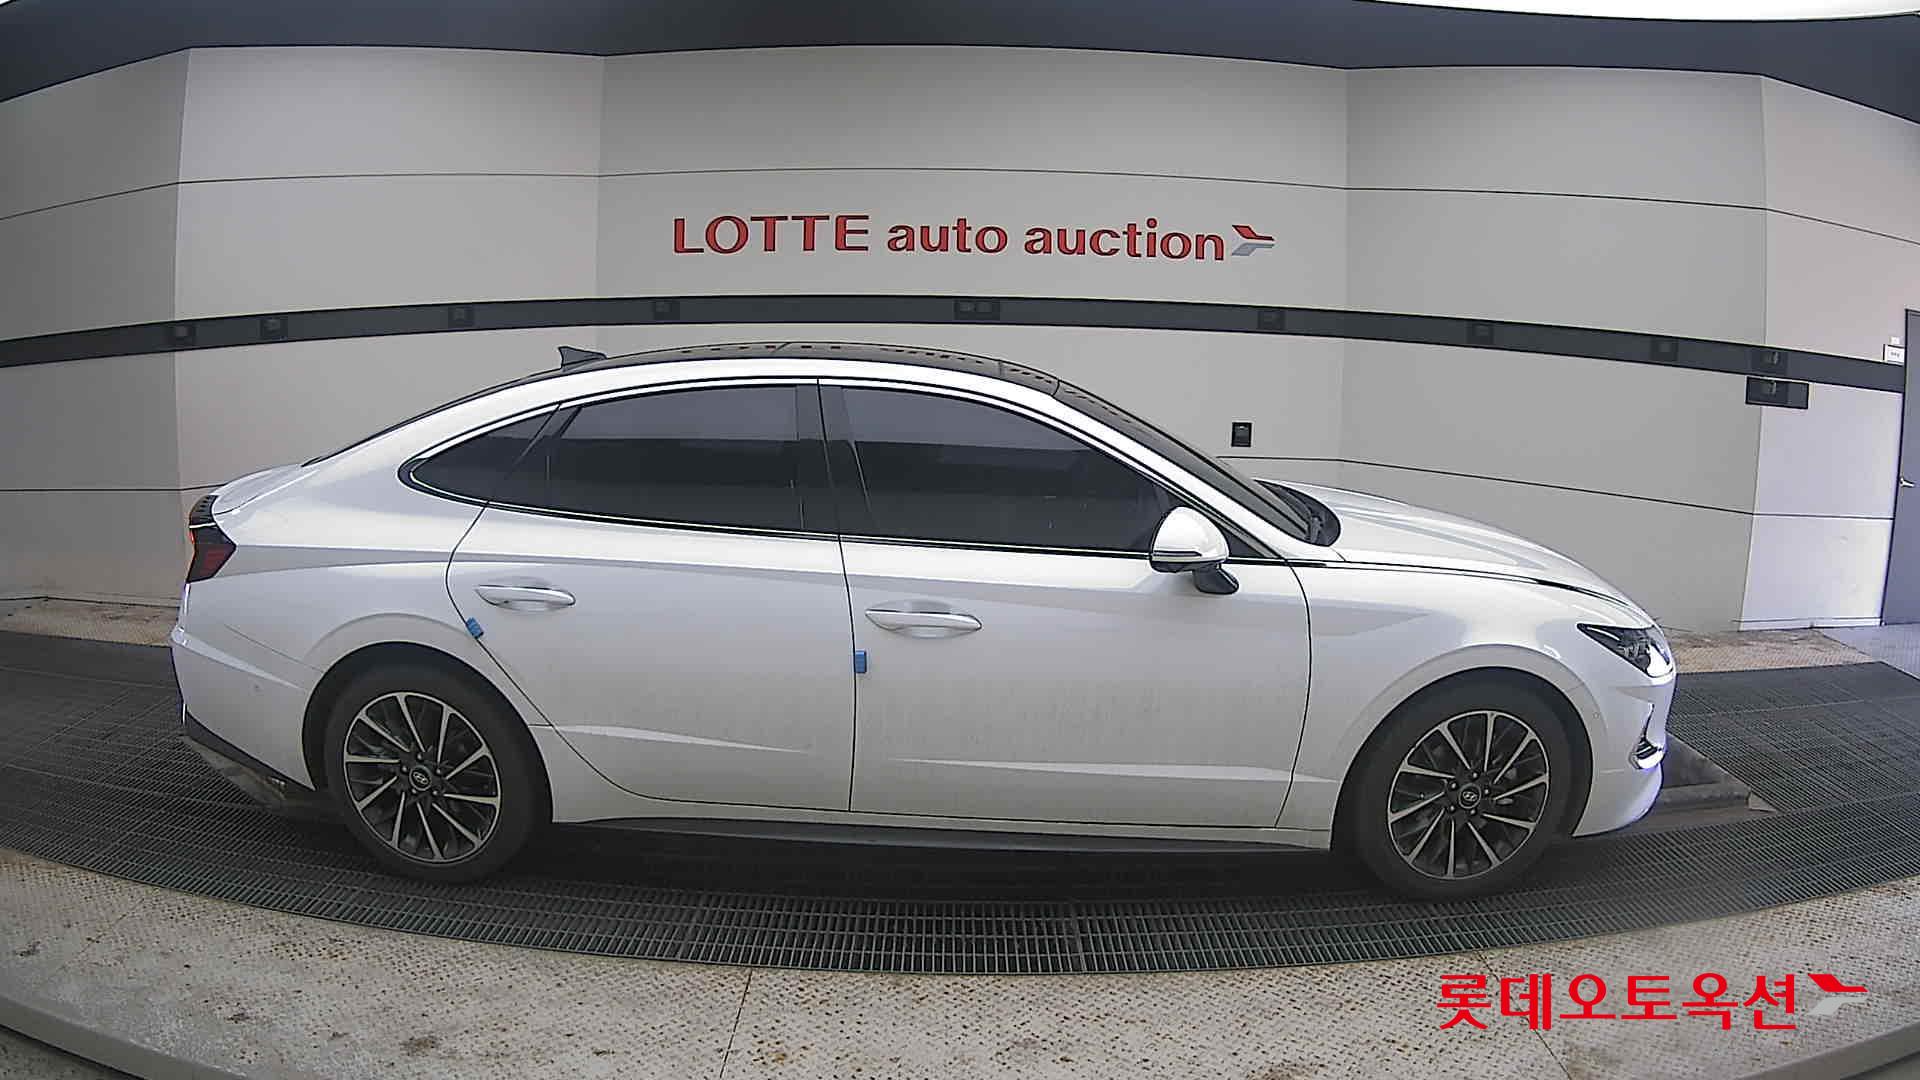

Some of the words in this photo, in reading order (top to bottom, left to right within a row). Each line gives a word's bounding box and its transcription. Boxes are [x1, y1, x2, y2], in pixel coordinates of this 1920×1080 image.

[673, 215, 869, 254] LOTTE
[887, 217, 1008, 253] auto
[1024, 217, 1225, 260] auction
